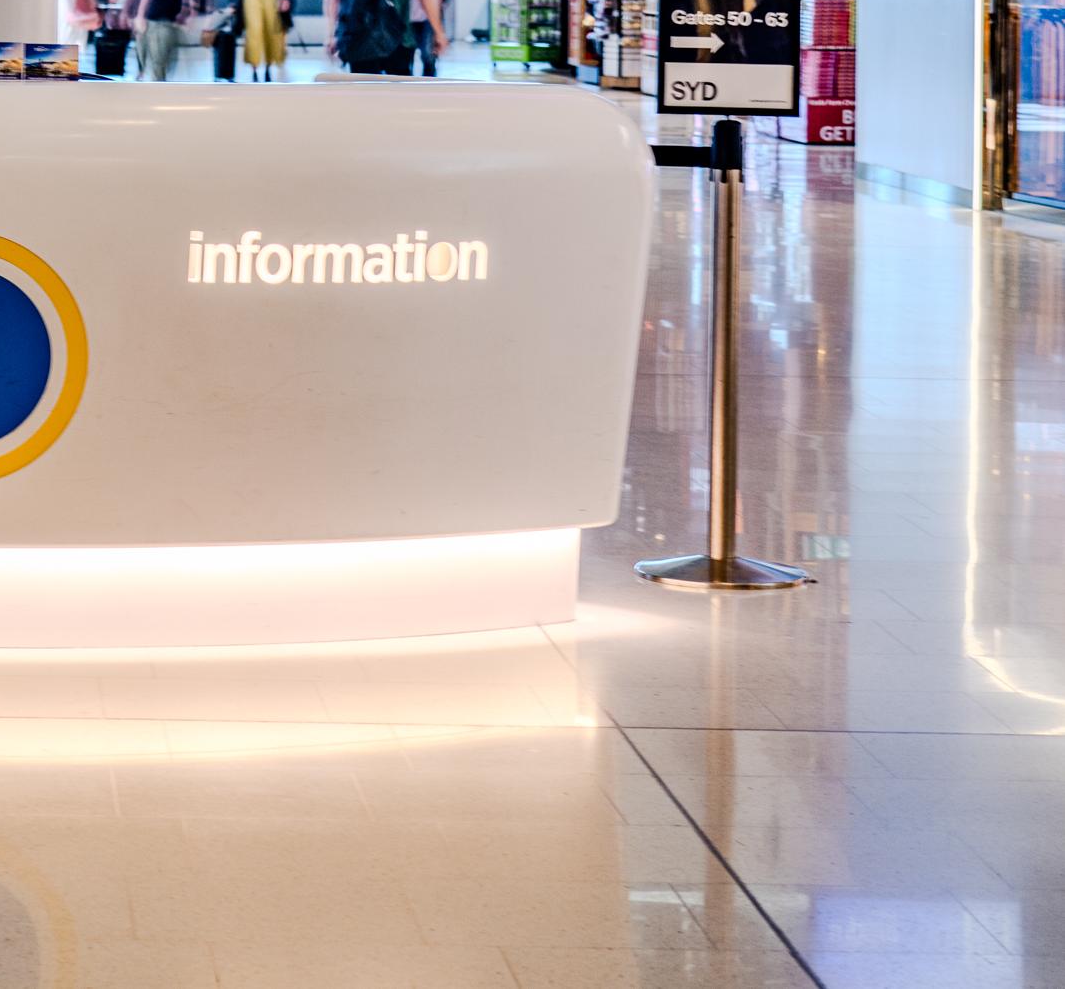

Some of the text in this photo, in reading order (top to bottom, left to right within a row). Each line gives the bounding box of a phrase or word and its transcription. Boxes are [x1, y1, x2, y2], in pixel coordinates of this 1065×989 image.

[671, 9, 726, 26] Gates
[727, 11, 752, 26] 50
[765, 11, 789, 27] 63
[671, 81, 718, 101] SYD
[187, 230, 489, 284] information
